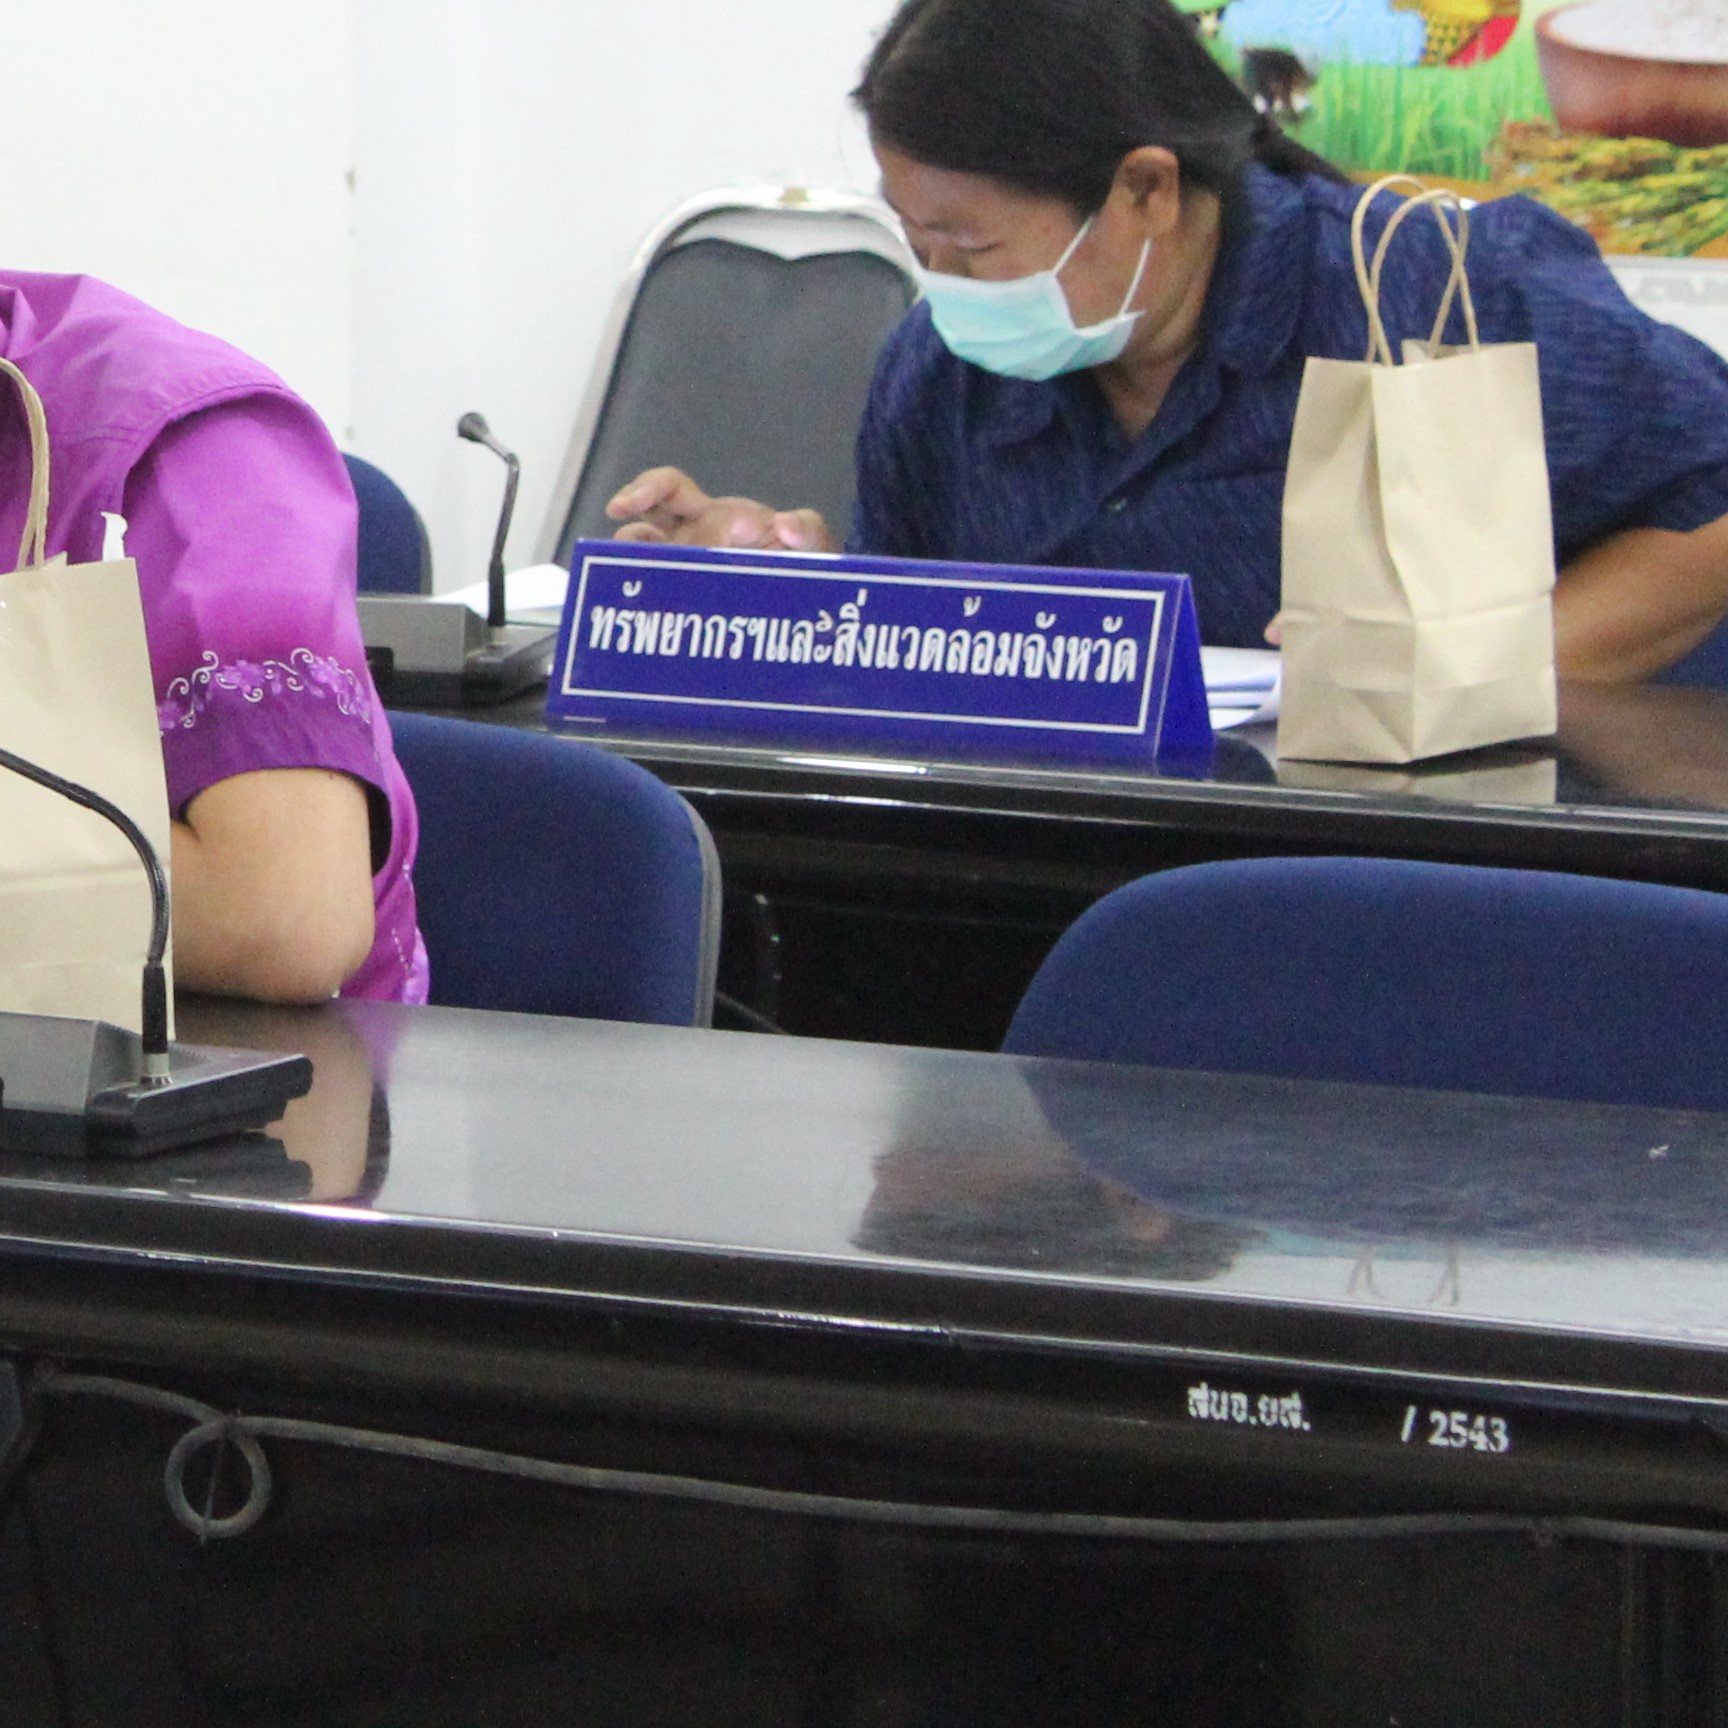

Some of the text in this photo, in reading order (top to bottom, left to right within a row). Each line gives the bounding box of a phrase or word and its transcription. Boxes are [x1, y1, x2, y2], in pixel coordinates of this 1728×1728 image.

[588, 579, 1138, 684] ทรัพยากรฯและสิ่งแวดล้อมจังหวัด
